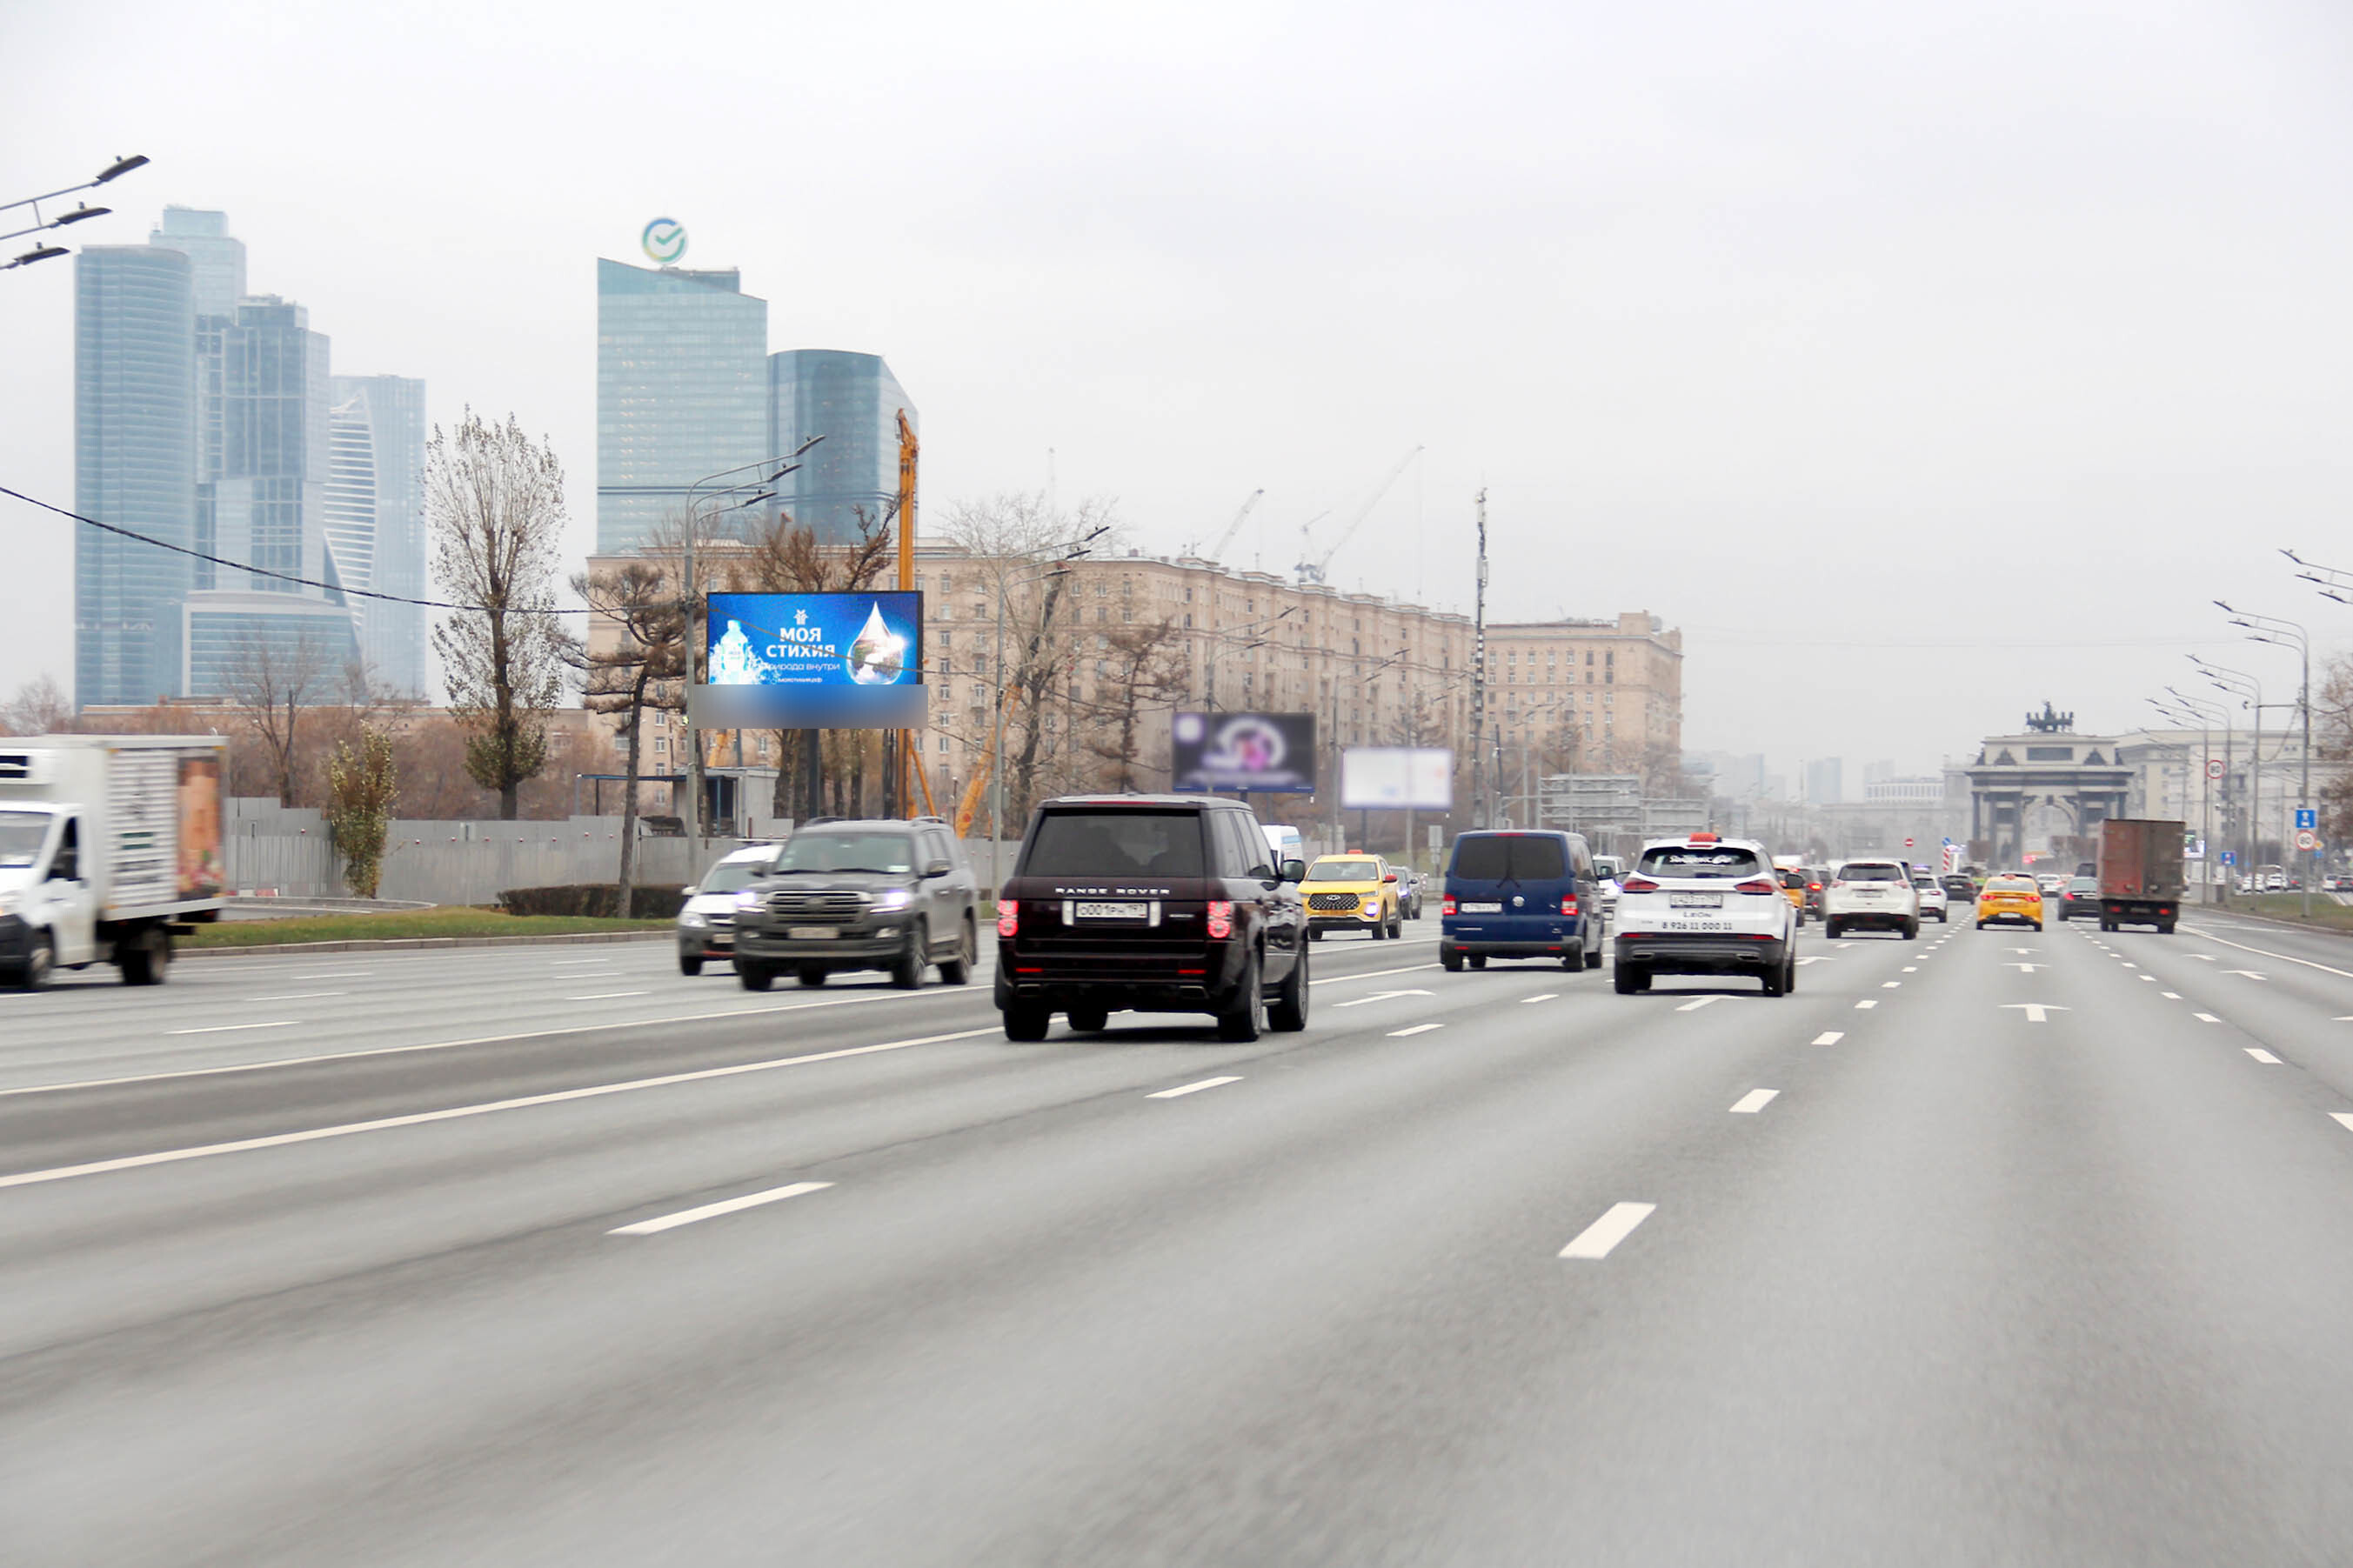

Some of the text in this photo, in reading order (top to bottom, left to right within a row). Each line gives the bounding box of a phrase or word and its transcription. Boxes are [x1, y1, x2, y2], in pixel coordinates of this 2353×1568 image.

[779, 627, 822, 642] МОЯ
[766, 644, 835, 658] СТИХИЯ
[806, 663, 840, 672] внутри
